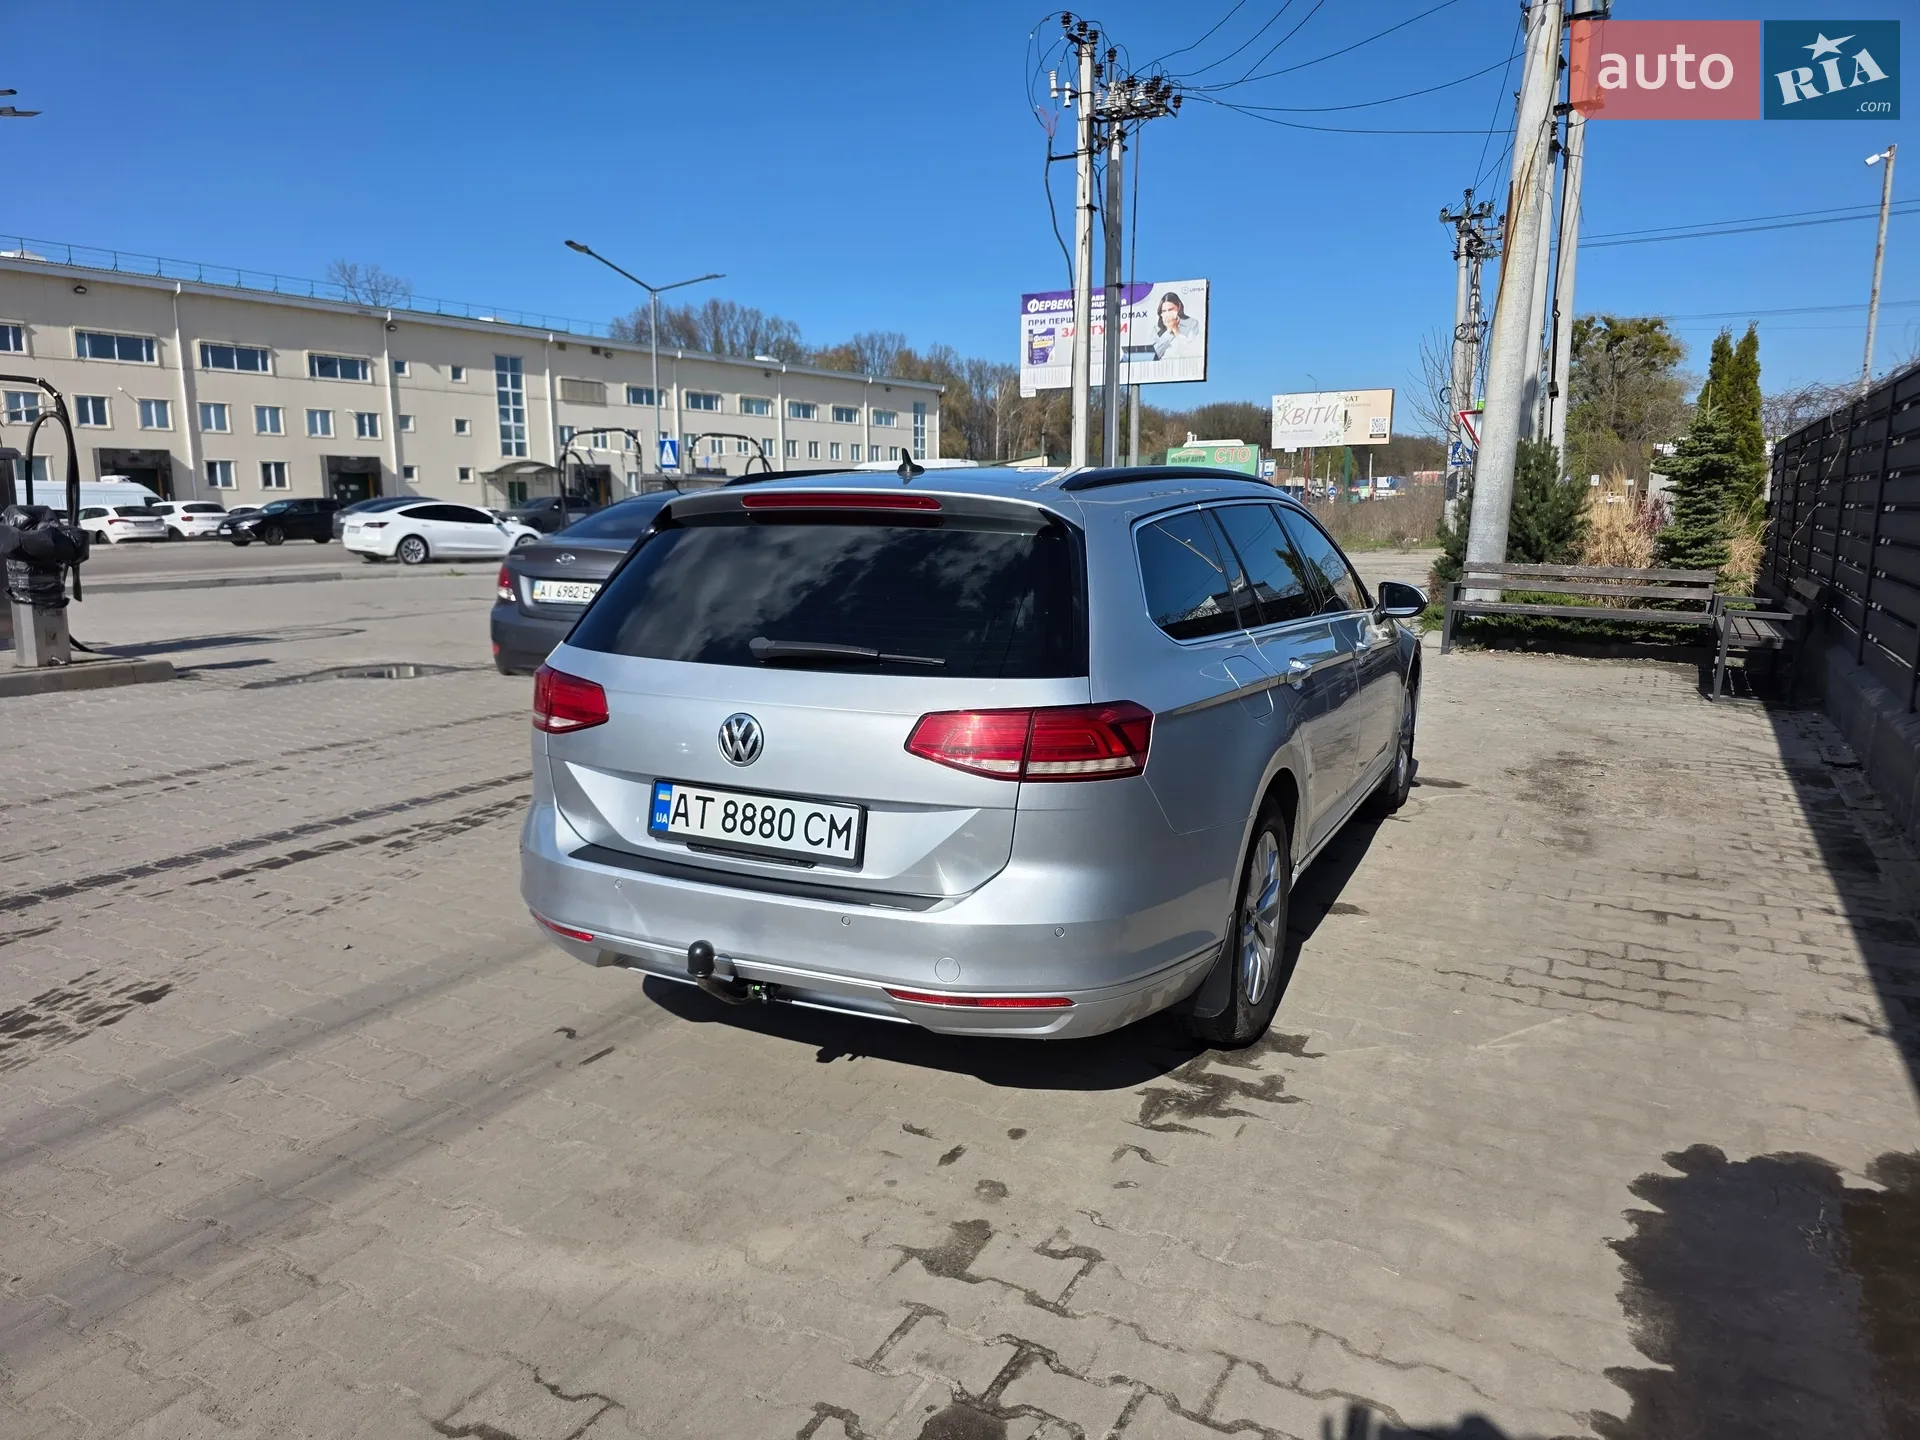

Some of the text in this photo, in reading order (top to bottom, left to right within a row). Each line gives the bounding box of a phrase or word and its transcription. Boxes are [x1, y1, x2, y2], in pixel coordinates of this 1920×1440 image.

[1280, 404, 1339, 426] КВІТИ
[1214, 447, 1251, 463] СТО
[556, 585, 580, 599] 6982
[655, 812, 668, 824] UA
[671, 793, 853, 851] AT 8880 CM
